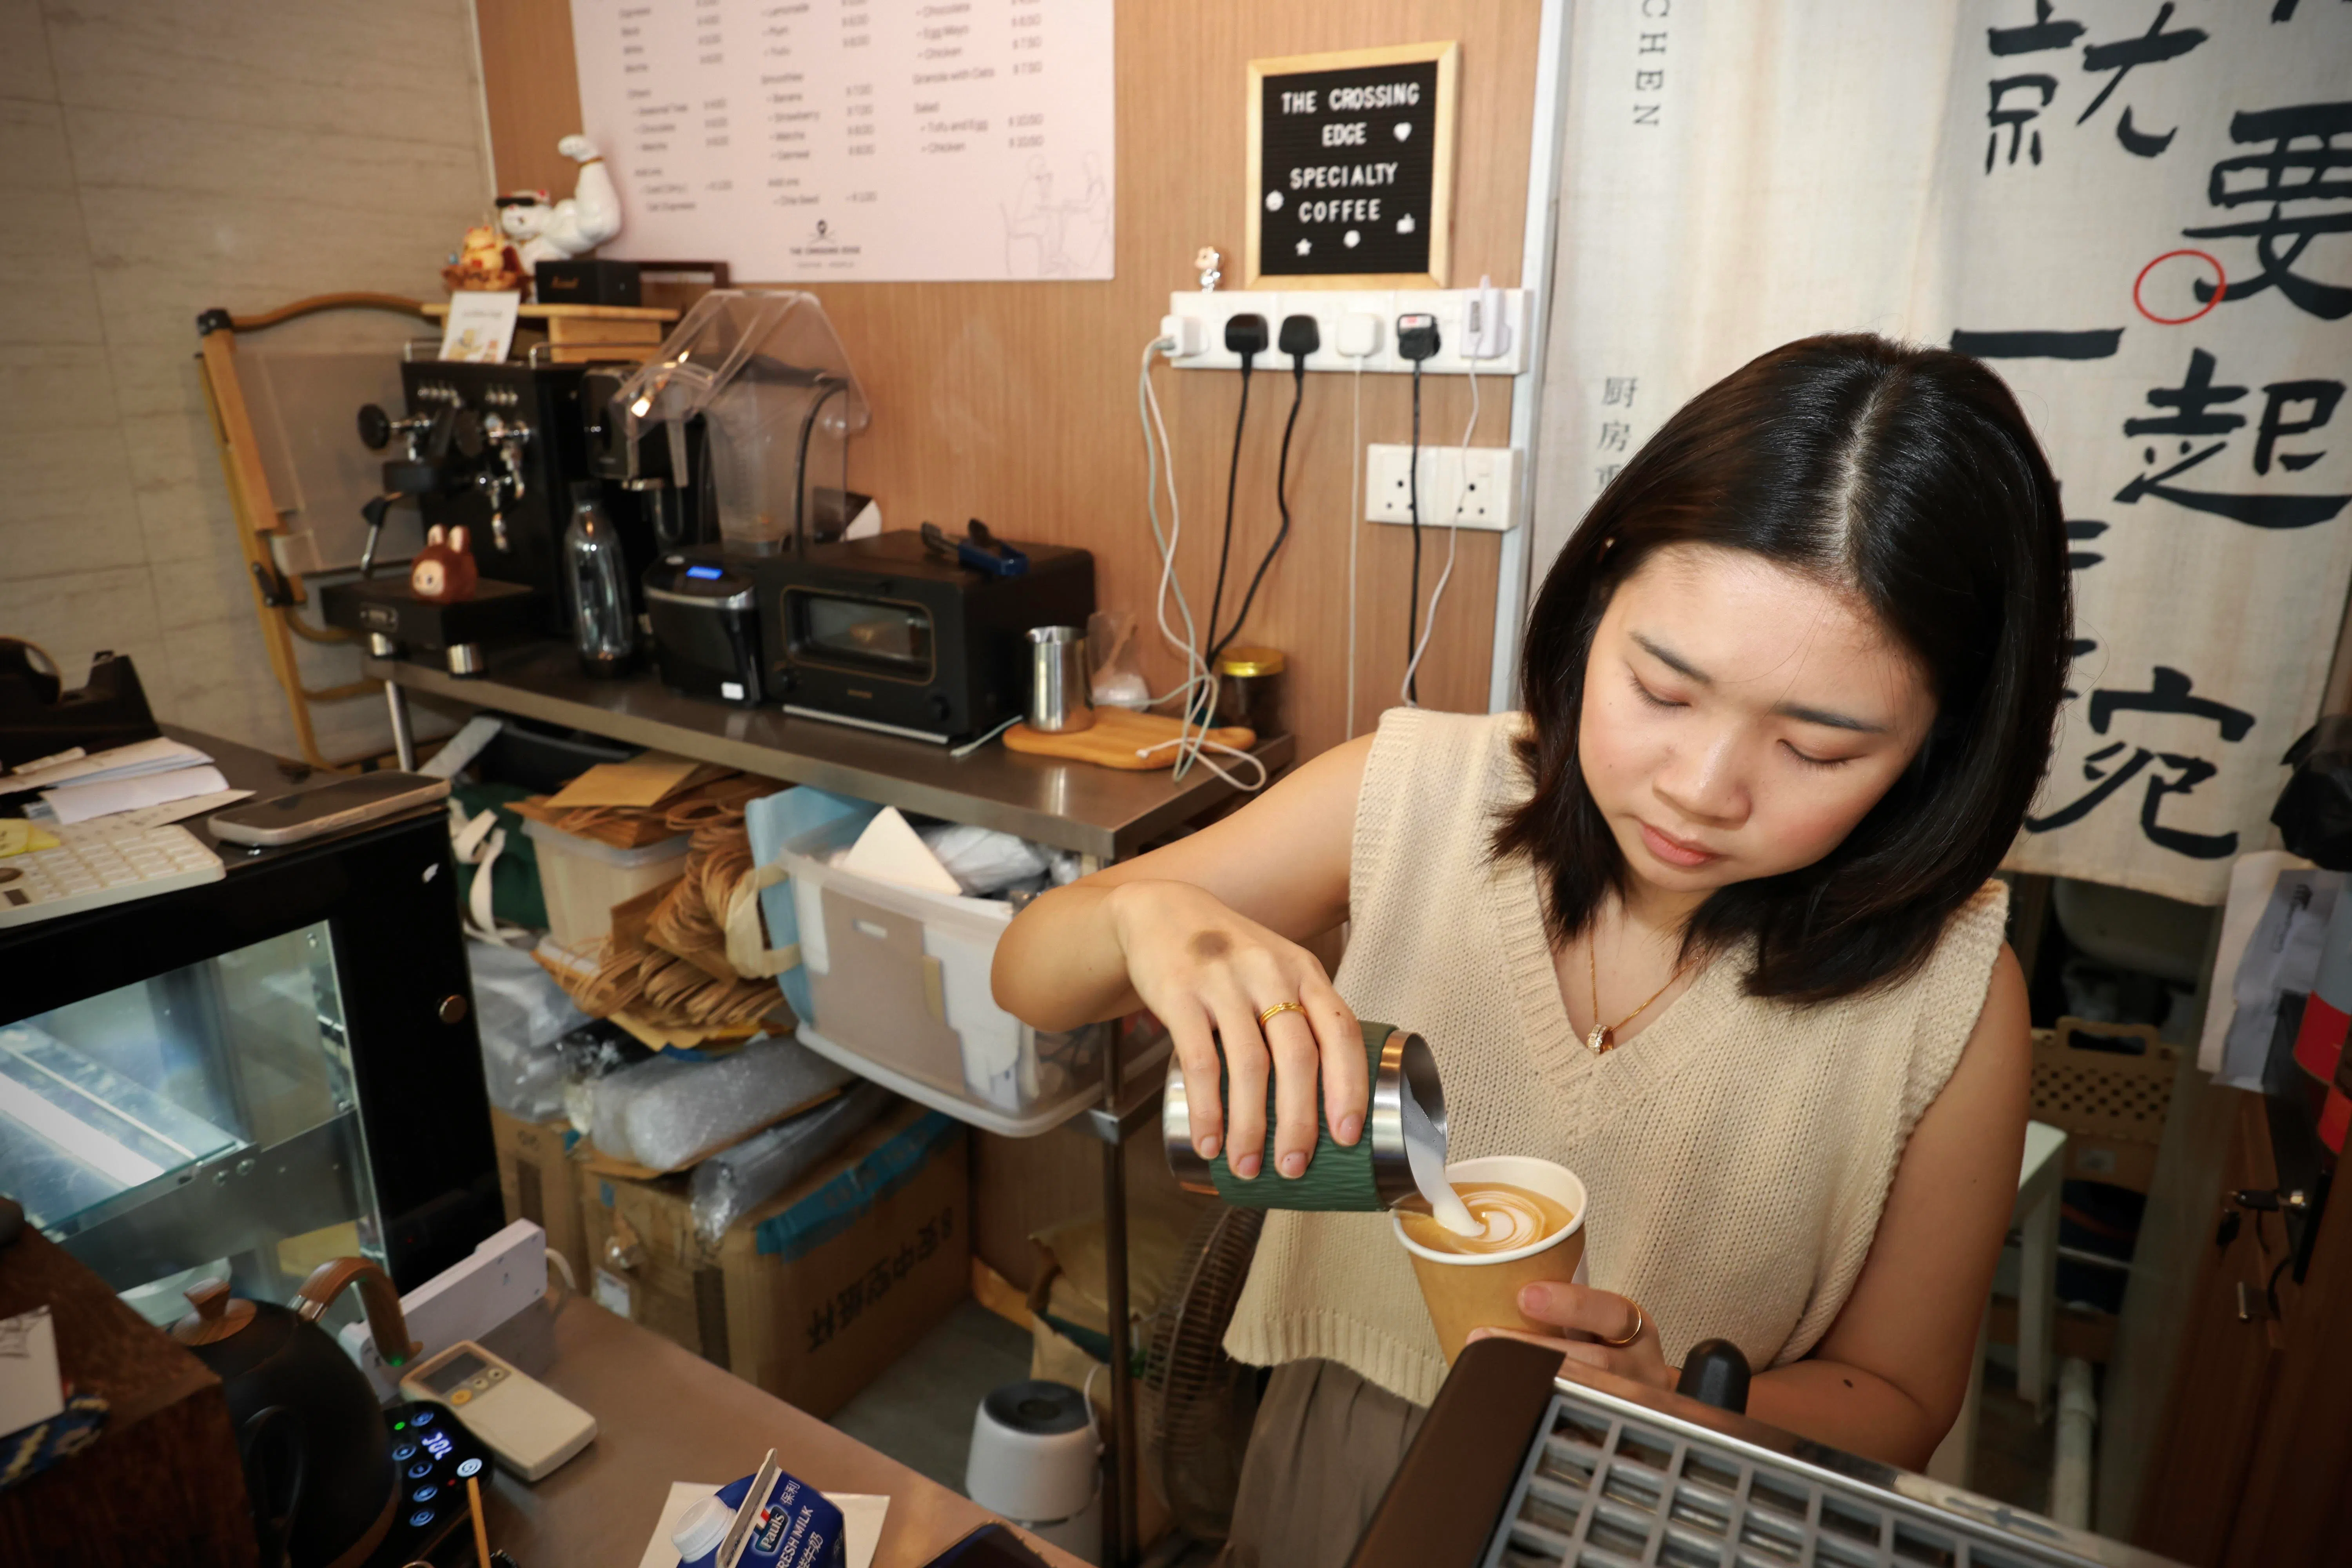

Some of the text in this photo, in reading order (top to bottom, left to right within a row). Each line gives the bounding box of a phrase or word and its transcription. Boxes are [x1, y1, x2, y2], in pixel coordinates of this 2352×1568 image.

[1633, 0, 1670, 125] CHEN
[1281, 82, 1420, 114] THE CROSSING
[1321, 122, 1367, 147] EDGE
[1289, 162, 1399, 190] SPECIALTY
[1298, 198, 1382, 224] COFFEE
[780, 1480, 800, 1506] 保利
[760, 1513, 785, 1549] Pauls
[775, 1505, 814, 1568] RESH MILK
